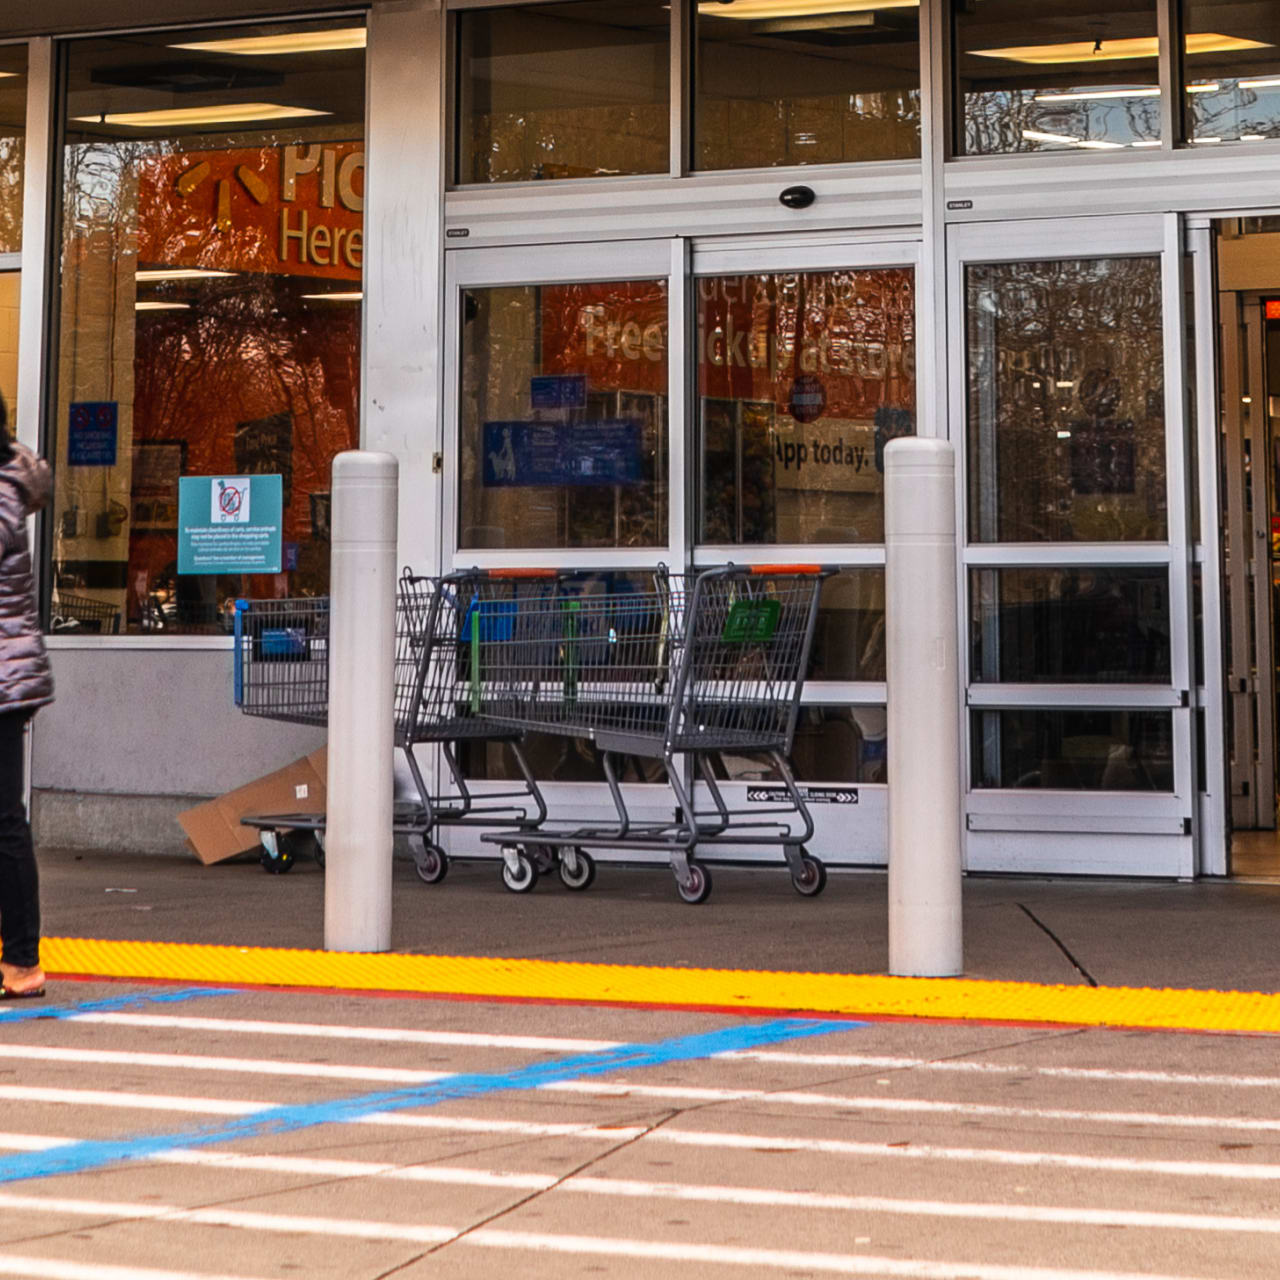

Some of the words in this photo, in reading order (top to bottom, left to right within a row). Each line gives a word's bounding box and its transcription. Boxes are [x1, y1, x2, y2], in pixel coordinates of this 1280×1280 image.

[281, 207, 363, 269] Here
[581, 305, 664, 361] Free
[697, 313, 790, 383] ickup
[813, 438, 869, 473] today.
